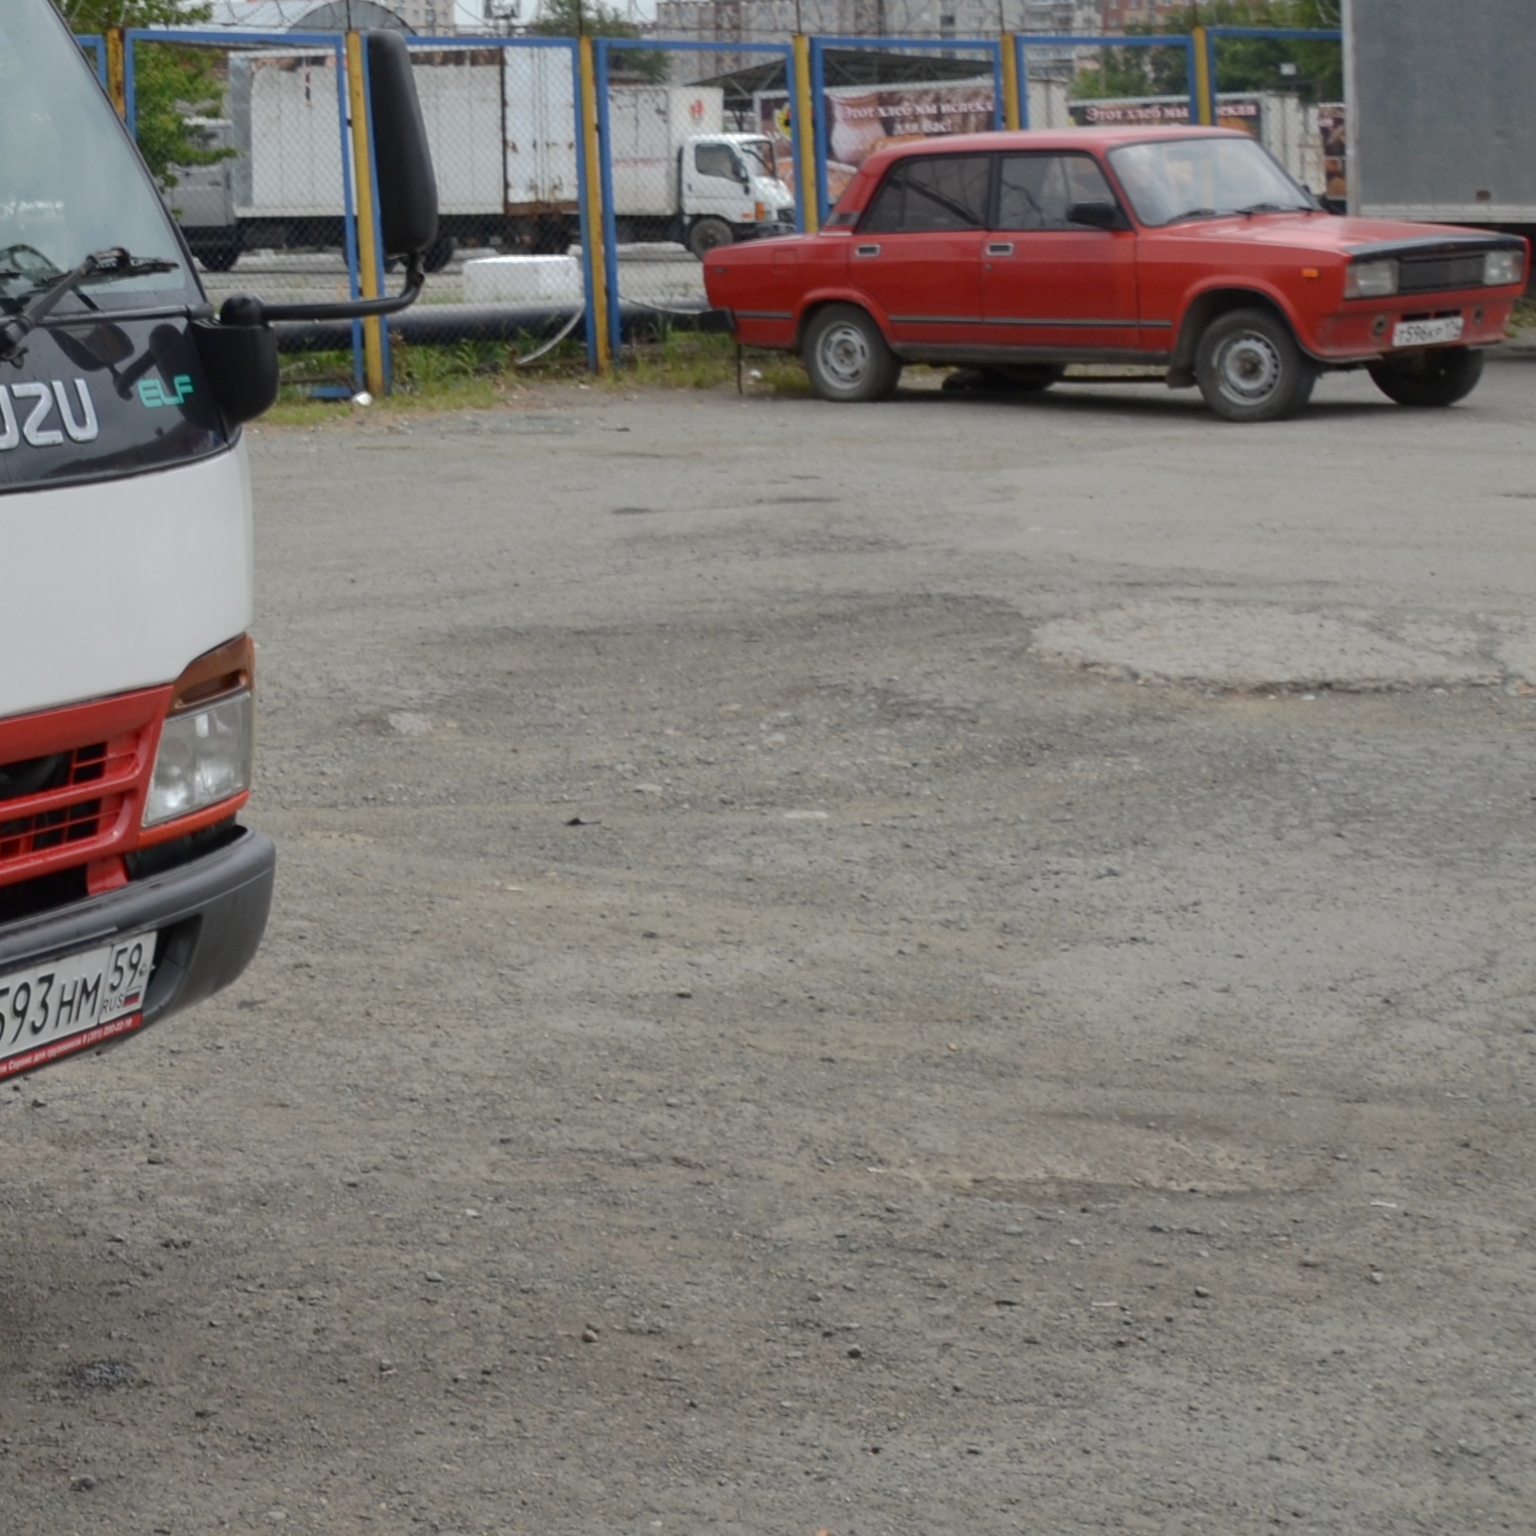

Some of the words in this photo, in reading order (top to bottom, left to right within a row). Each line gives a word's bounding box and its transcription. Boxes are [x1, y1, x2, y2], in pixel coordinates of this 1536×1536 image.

[1086, 107, 1123, 121] Этот
[1127, 104, 1161, 120] хлеб
[1164, 107, 1190, 118] мы
[138, 375, 194, 408] ELF
[109, 942, 143, 992] 59
[102, 994, 124, 1014] RUS
